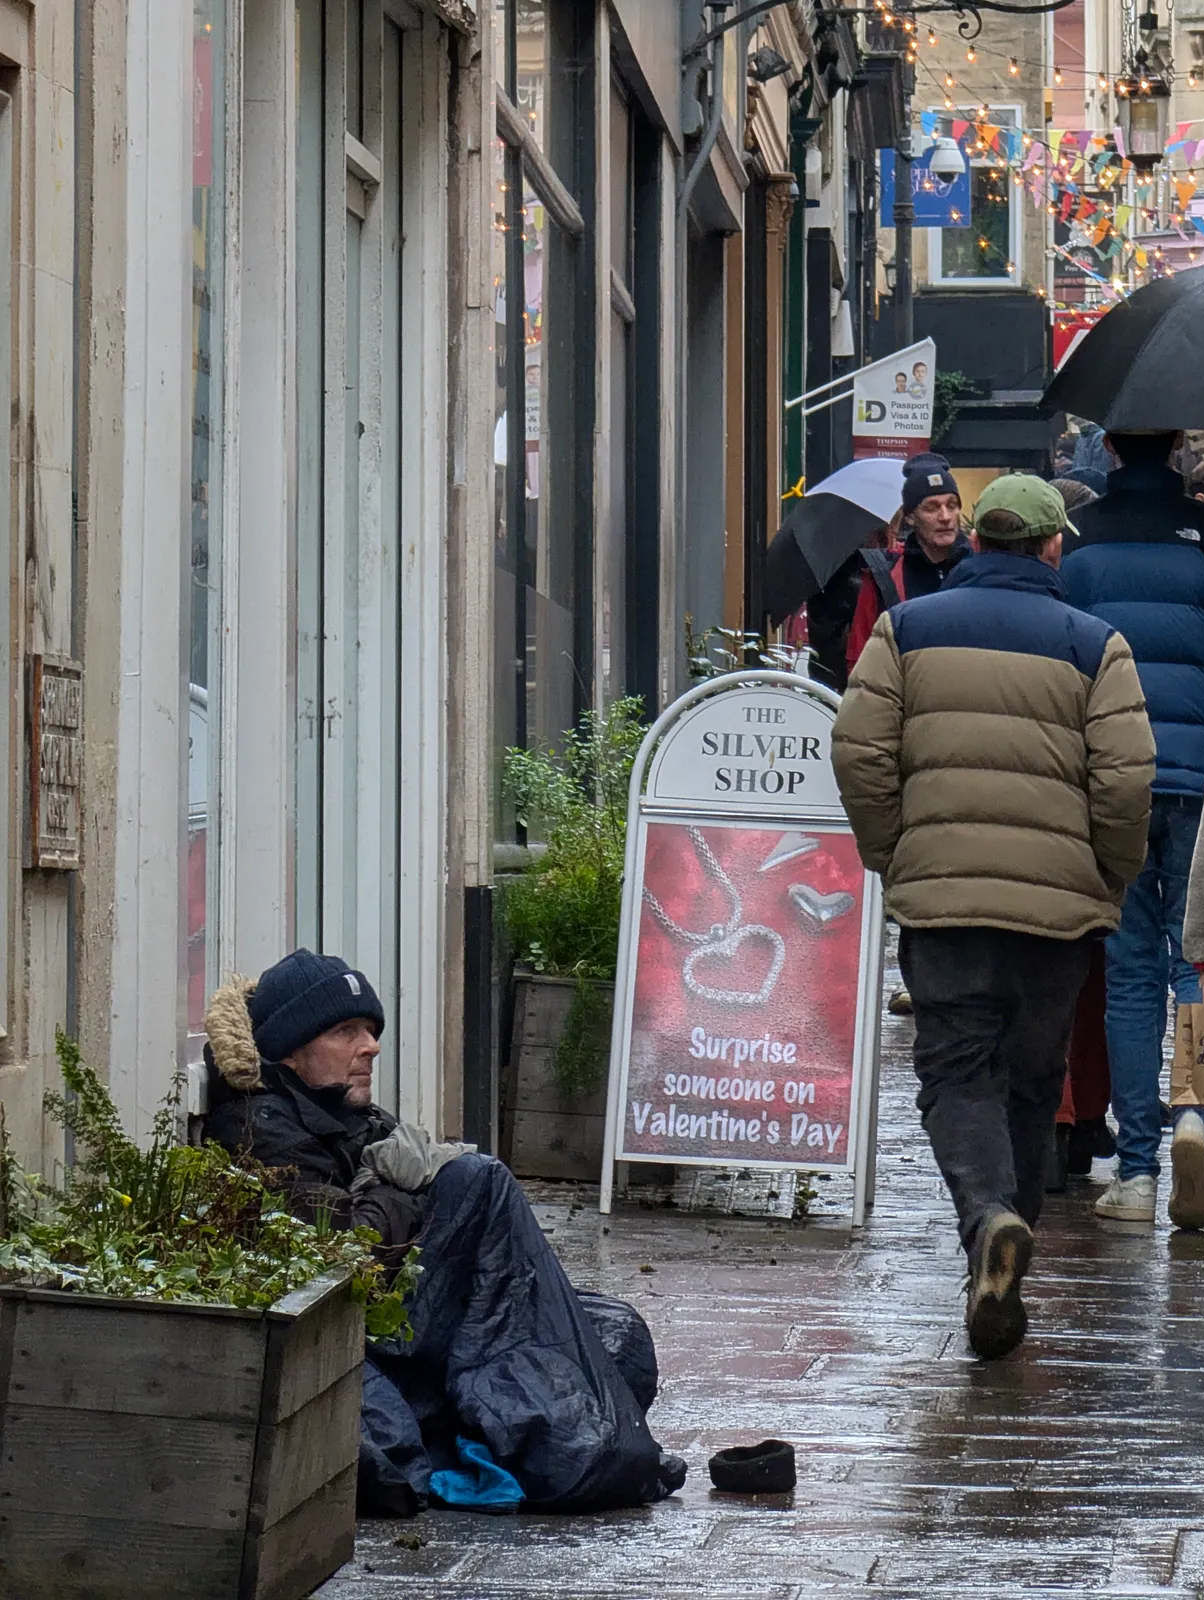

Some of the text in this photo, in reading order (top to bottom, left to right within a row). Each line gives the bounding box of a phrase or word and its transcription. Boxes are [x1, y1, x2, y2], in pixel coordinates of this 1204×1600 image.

[891, 401, 929, 411] Passport
[891, 412, 929, 420] Visa & ID
[894, 422, 924, 431] Photos
[876, 438, 908, 446] TIMPSON
[742, 706, 786, 724] THE
[701, 731, 822, 761] SILVER
[714, 767, 805, 795] SHOP
[688, 1026, 798, 1068] Surprise
[663, 1073, 816, 1105] someone on
[632, 1101, 843, 1153] Valentine's Day
